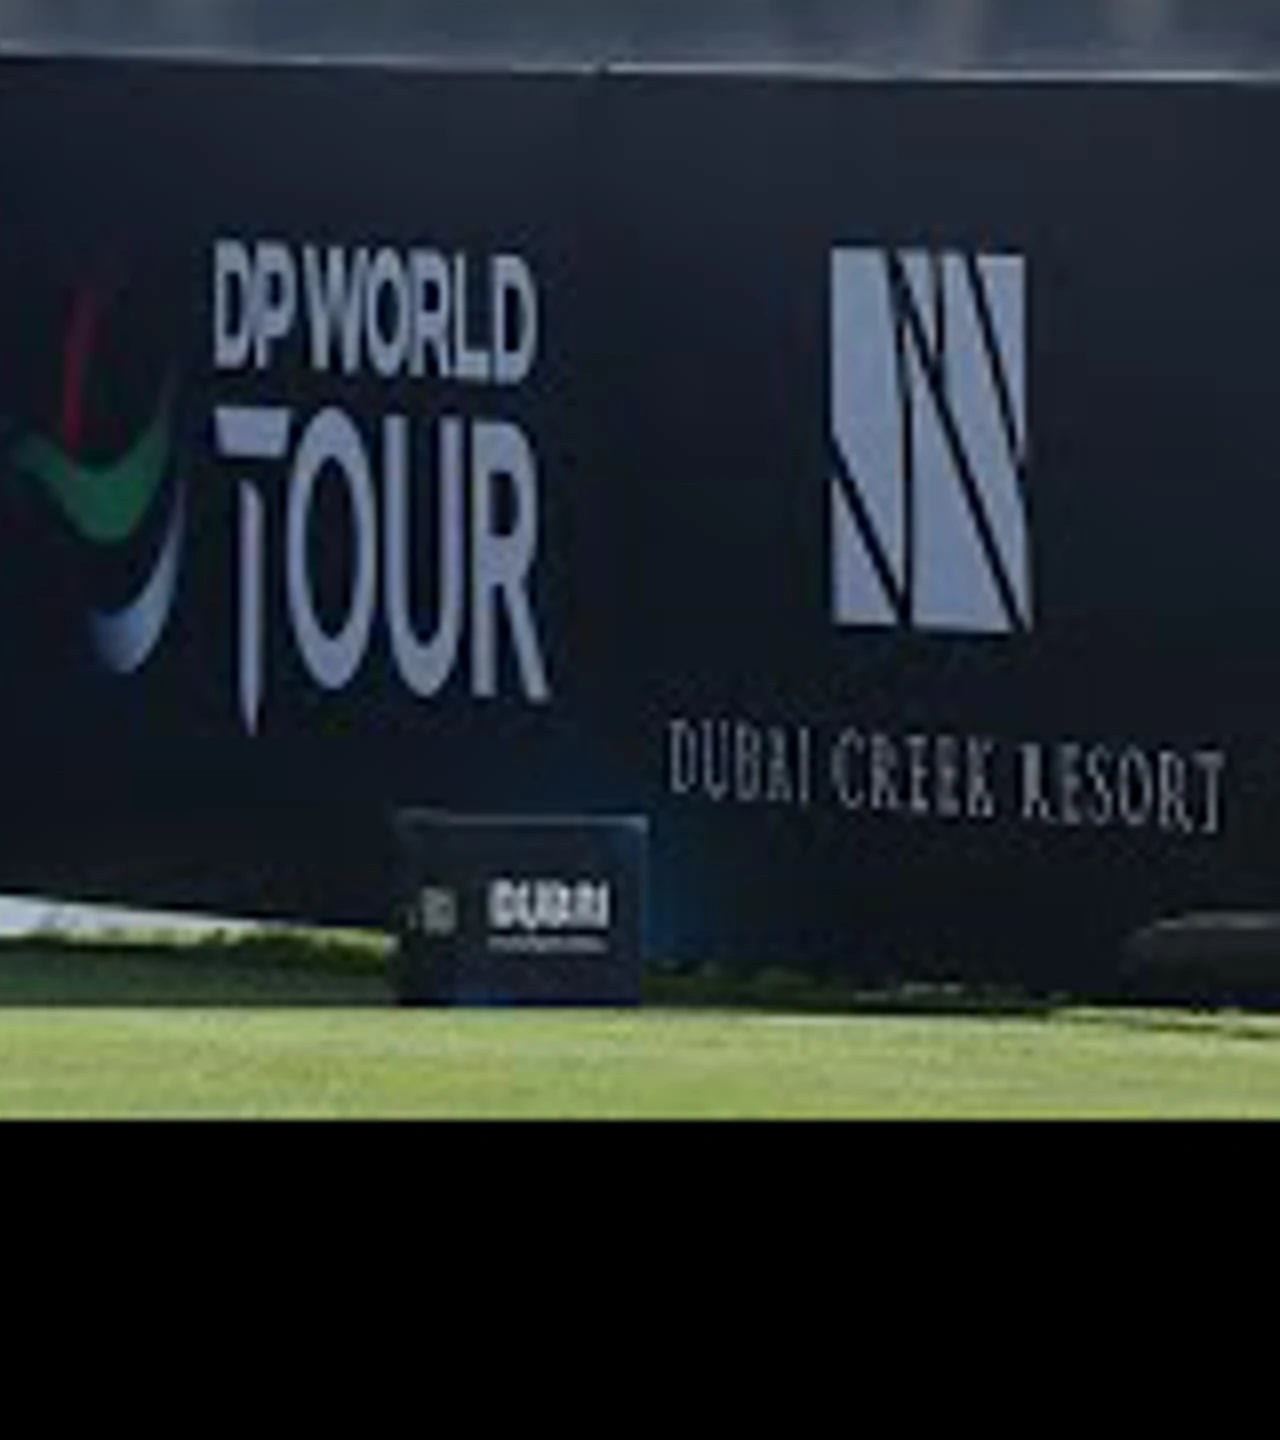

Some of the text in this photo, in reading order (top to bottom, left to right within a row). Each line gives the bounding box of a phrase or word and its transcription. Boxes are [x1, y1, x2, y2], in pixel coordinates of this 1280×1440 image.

[213, 239, 538, 385] DP WORLD
[213, 405, 550, 734] TOUR
[667, 717, 1226, 835] DUBAI CREEK RESORT
